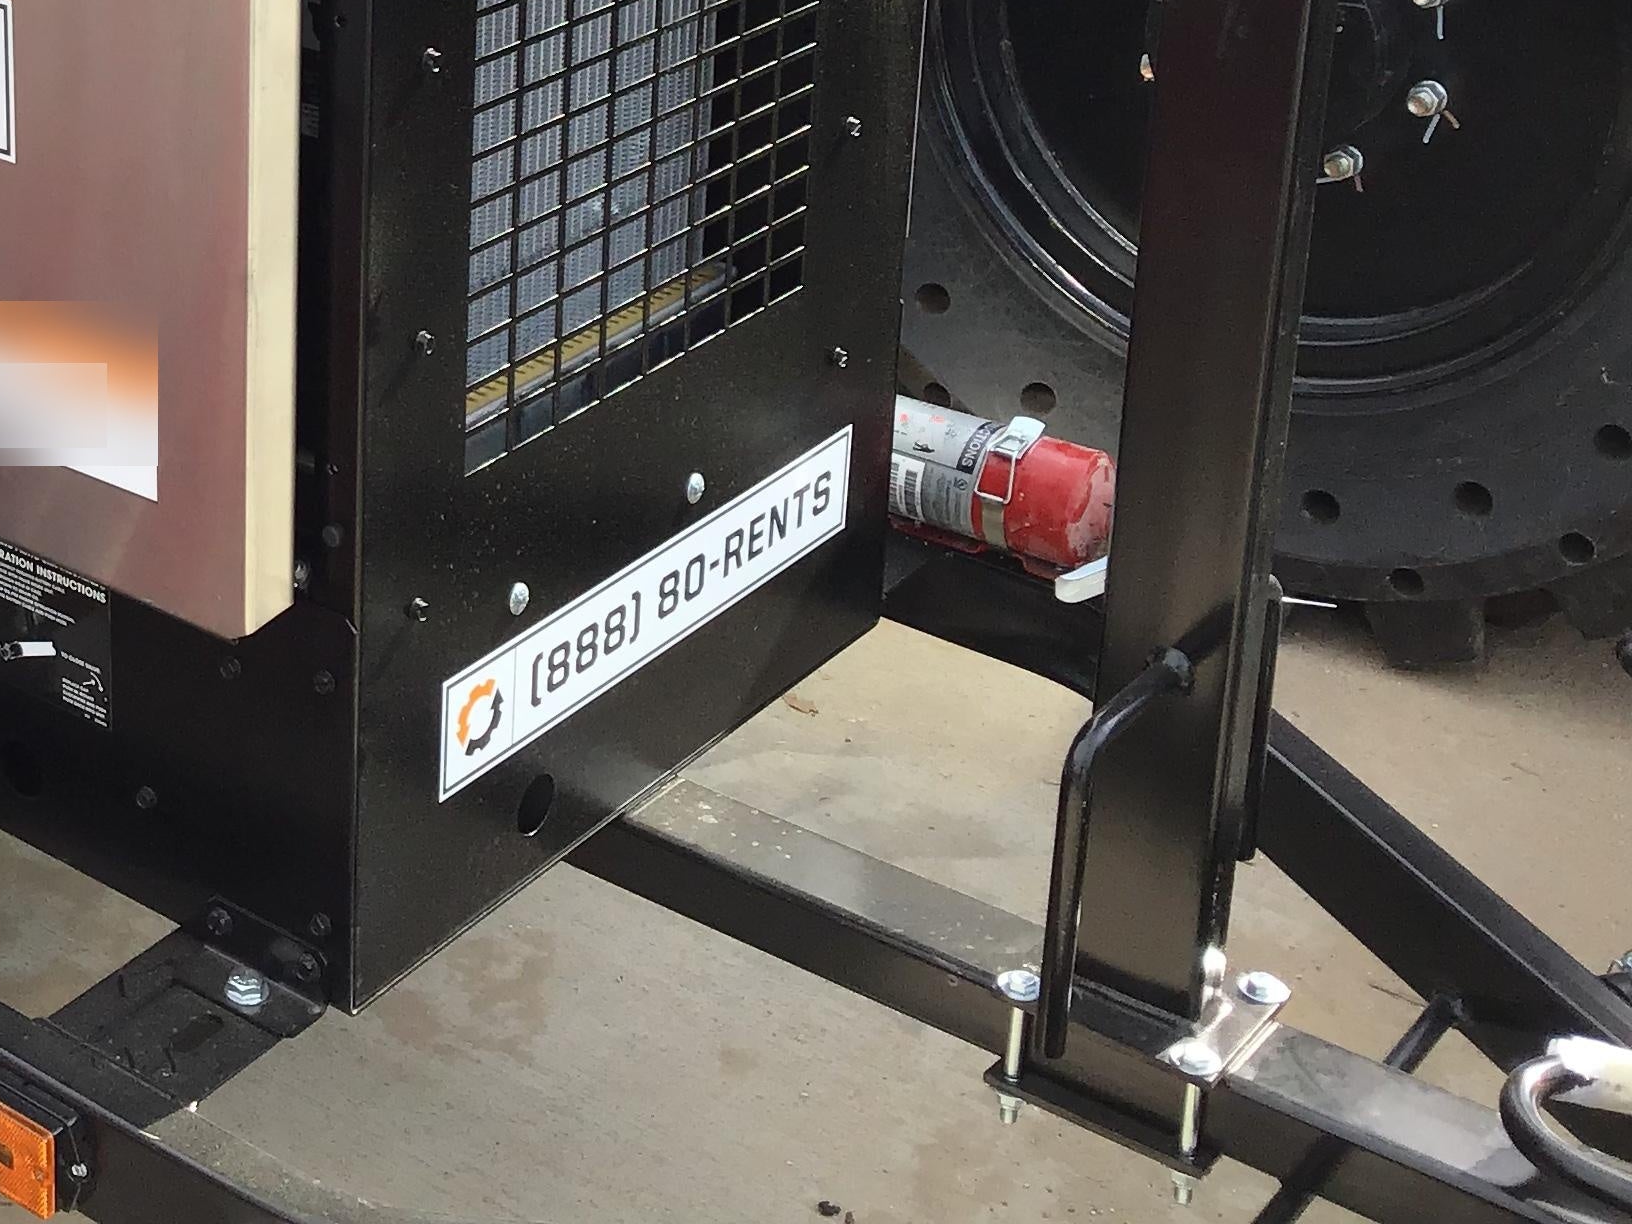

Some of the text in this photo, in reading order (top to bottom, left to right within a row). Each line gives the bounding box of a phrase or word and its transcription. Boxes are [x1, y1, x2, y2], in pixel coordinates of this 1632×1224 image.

[36, 564, 107, 604] INSTRUCTIONS
[531, 591, 641, 707] (888)
[658, 470, 832, 619] 80-RENTS
